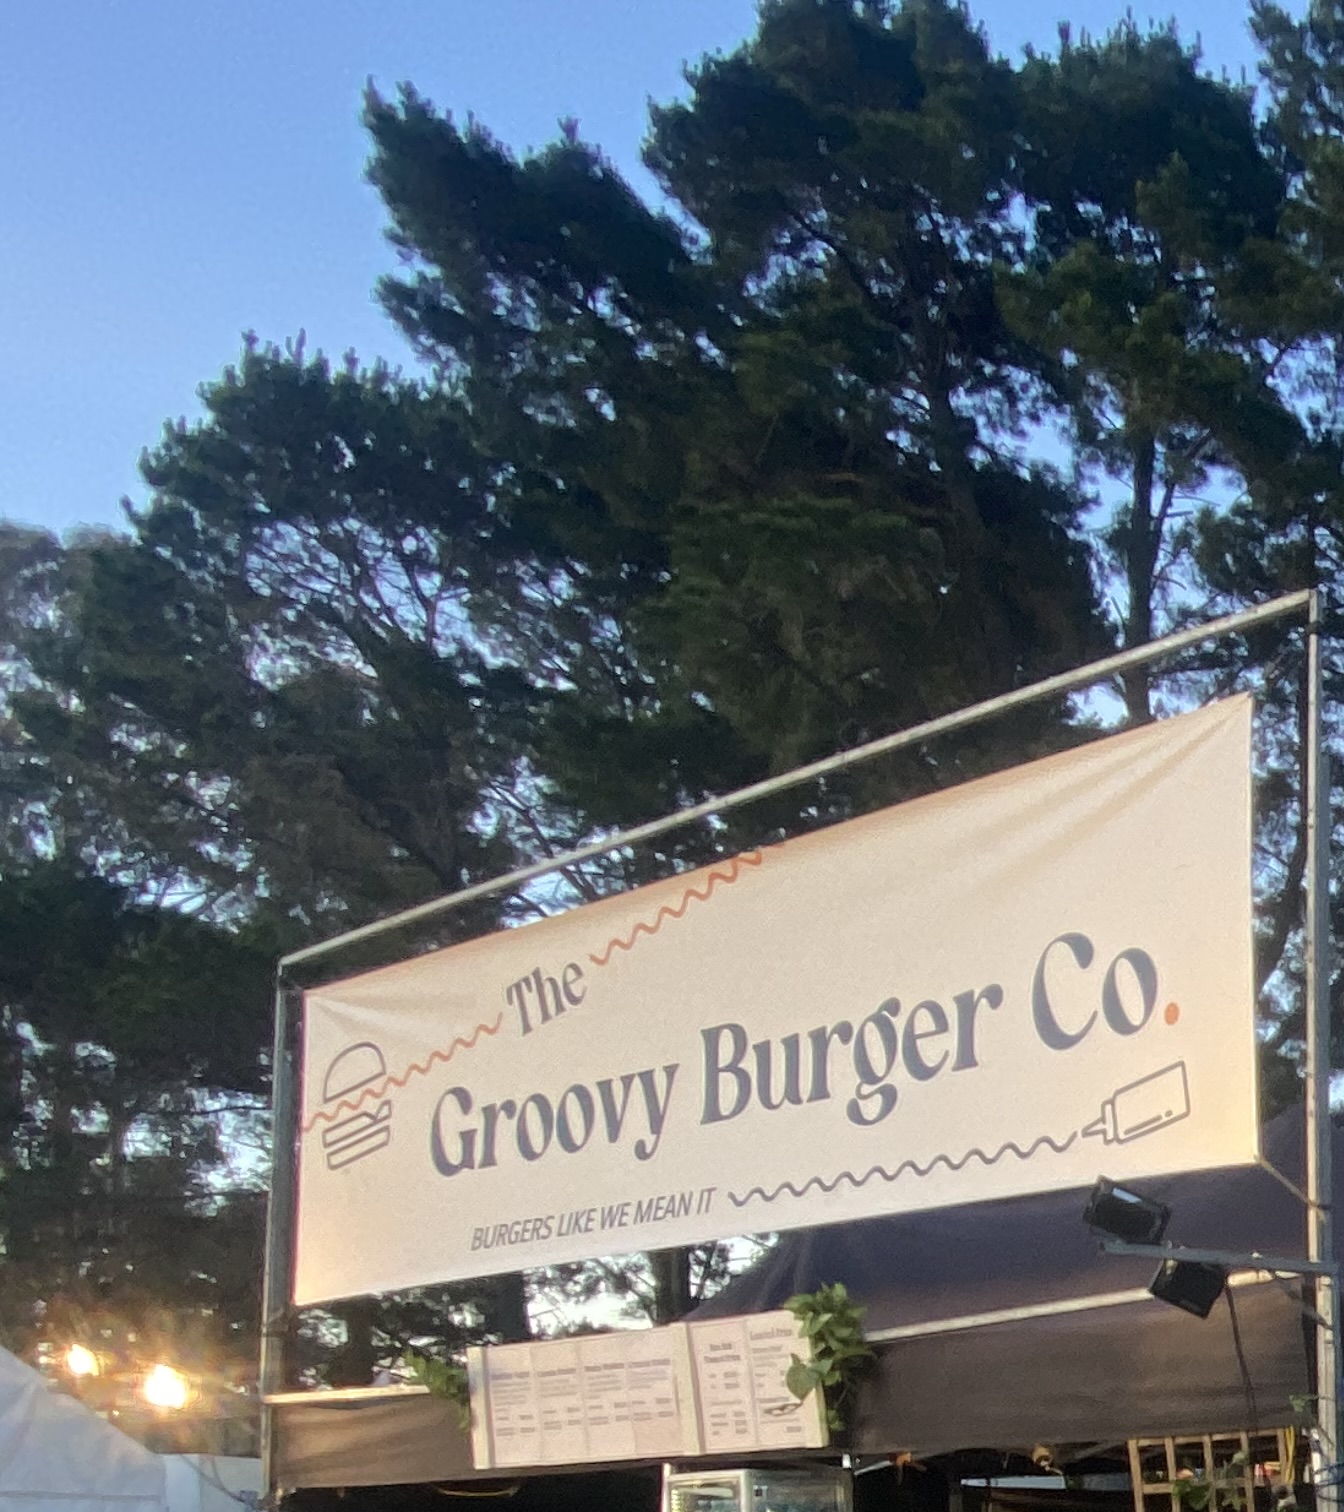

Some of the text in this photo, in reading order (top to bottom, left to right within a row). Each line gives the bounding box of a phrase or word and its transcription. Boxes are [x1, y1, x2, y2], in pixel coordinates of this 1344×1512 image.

[504, 962, 588, 1036] The
[431, 931, 1180, 1177] Groovy Burger Co.
[470, 1186, 718, 1250] BURGERS LIKE WE MEAN IT
